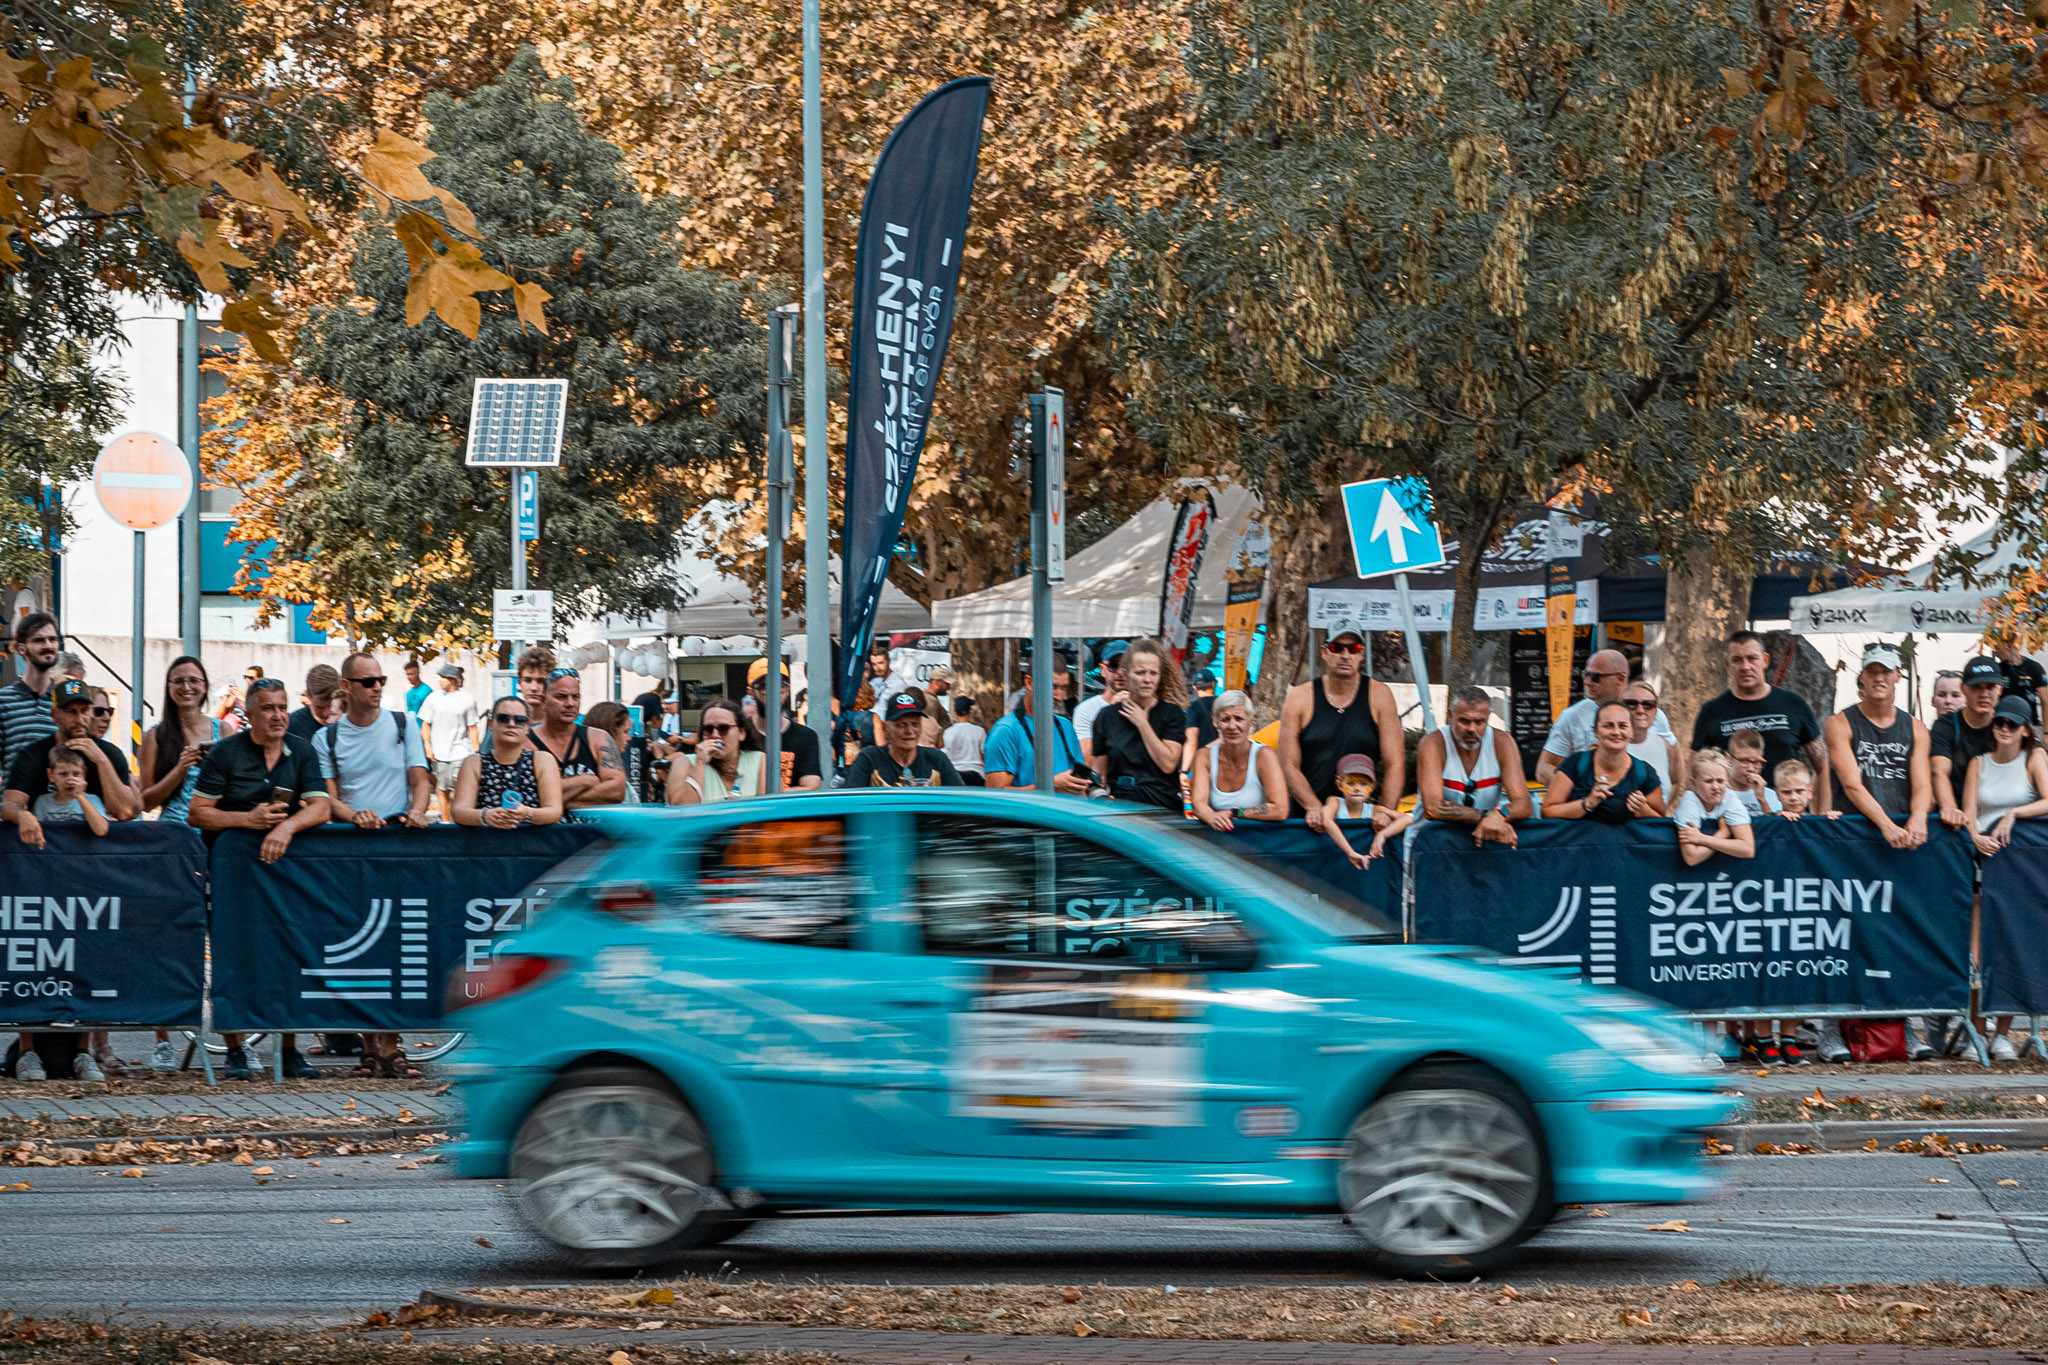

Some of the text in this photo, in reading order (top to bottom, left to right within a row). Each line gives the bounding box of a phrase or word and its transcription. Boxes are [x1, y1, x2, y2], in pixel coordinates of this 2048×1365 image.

[1648, 872, 1893, 917] SZÉCHENYI
[1650, 917, 1852, 957] EGYETEM
[1650, 955, 1849, 983] UNIVERSITY OF GYŐR
[13, 976, 74, 998] GYŐR
